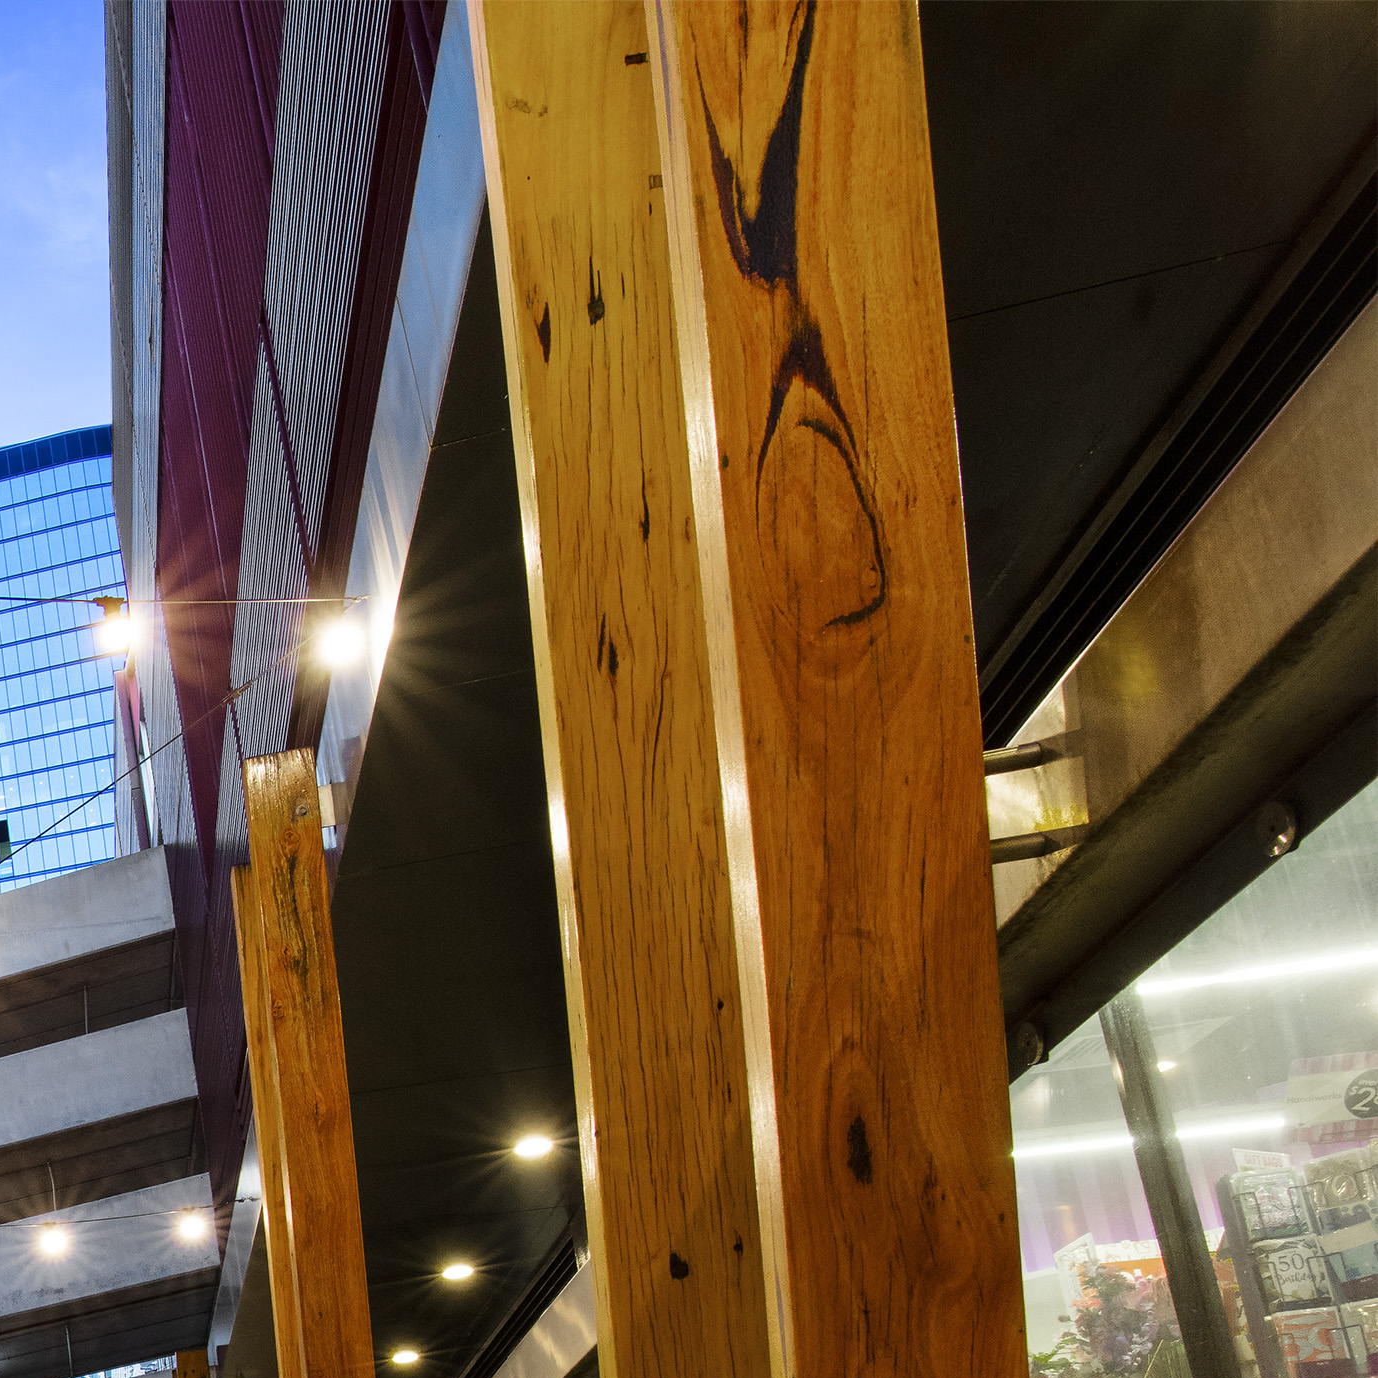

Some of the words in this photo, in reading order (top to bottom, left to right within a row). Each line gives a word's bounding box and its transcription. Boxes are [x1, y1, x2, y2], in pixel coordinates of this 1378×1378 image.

[1350, 1086, 1378, 1111] $2
[1244, 1154, 1260, 1166] GIFT
[1263, 1155, 1282, 1167] BAGS
[1278, 1253, 1305, 1272] 50
